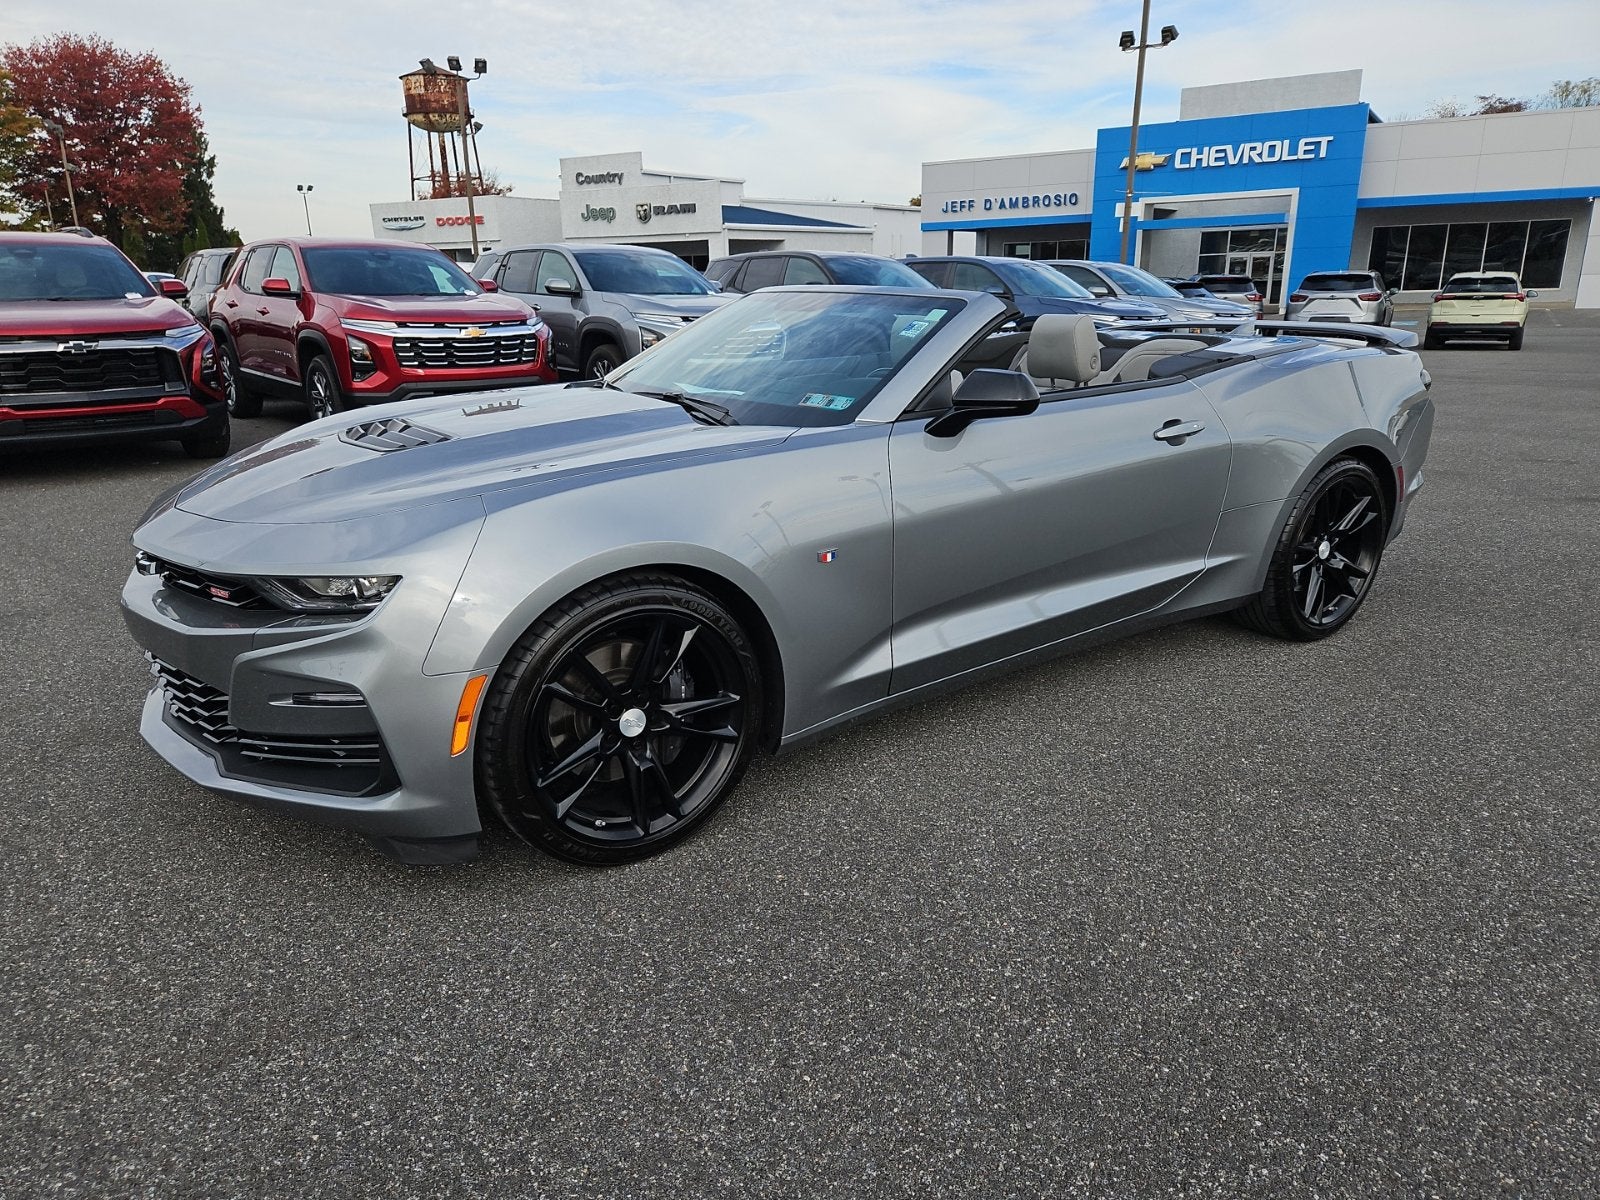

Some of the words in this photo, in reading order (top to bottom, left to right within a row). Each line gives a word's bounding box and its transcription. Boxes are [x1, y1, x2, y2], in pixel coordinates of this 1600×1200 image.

[1174, 135, 1334, 169] CHEVROLET
[575, 171, 624, 186] Country
[580, 203, 617, 223] Jeep
[652, 203, 697, 216] RAM
[941, 199, 976, 214] JEFF
[983, 192, 1079, 211] D'AMBROSIO
